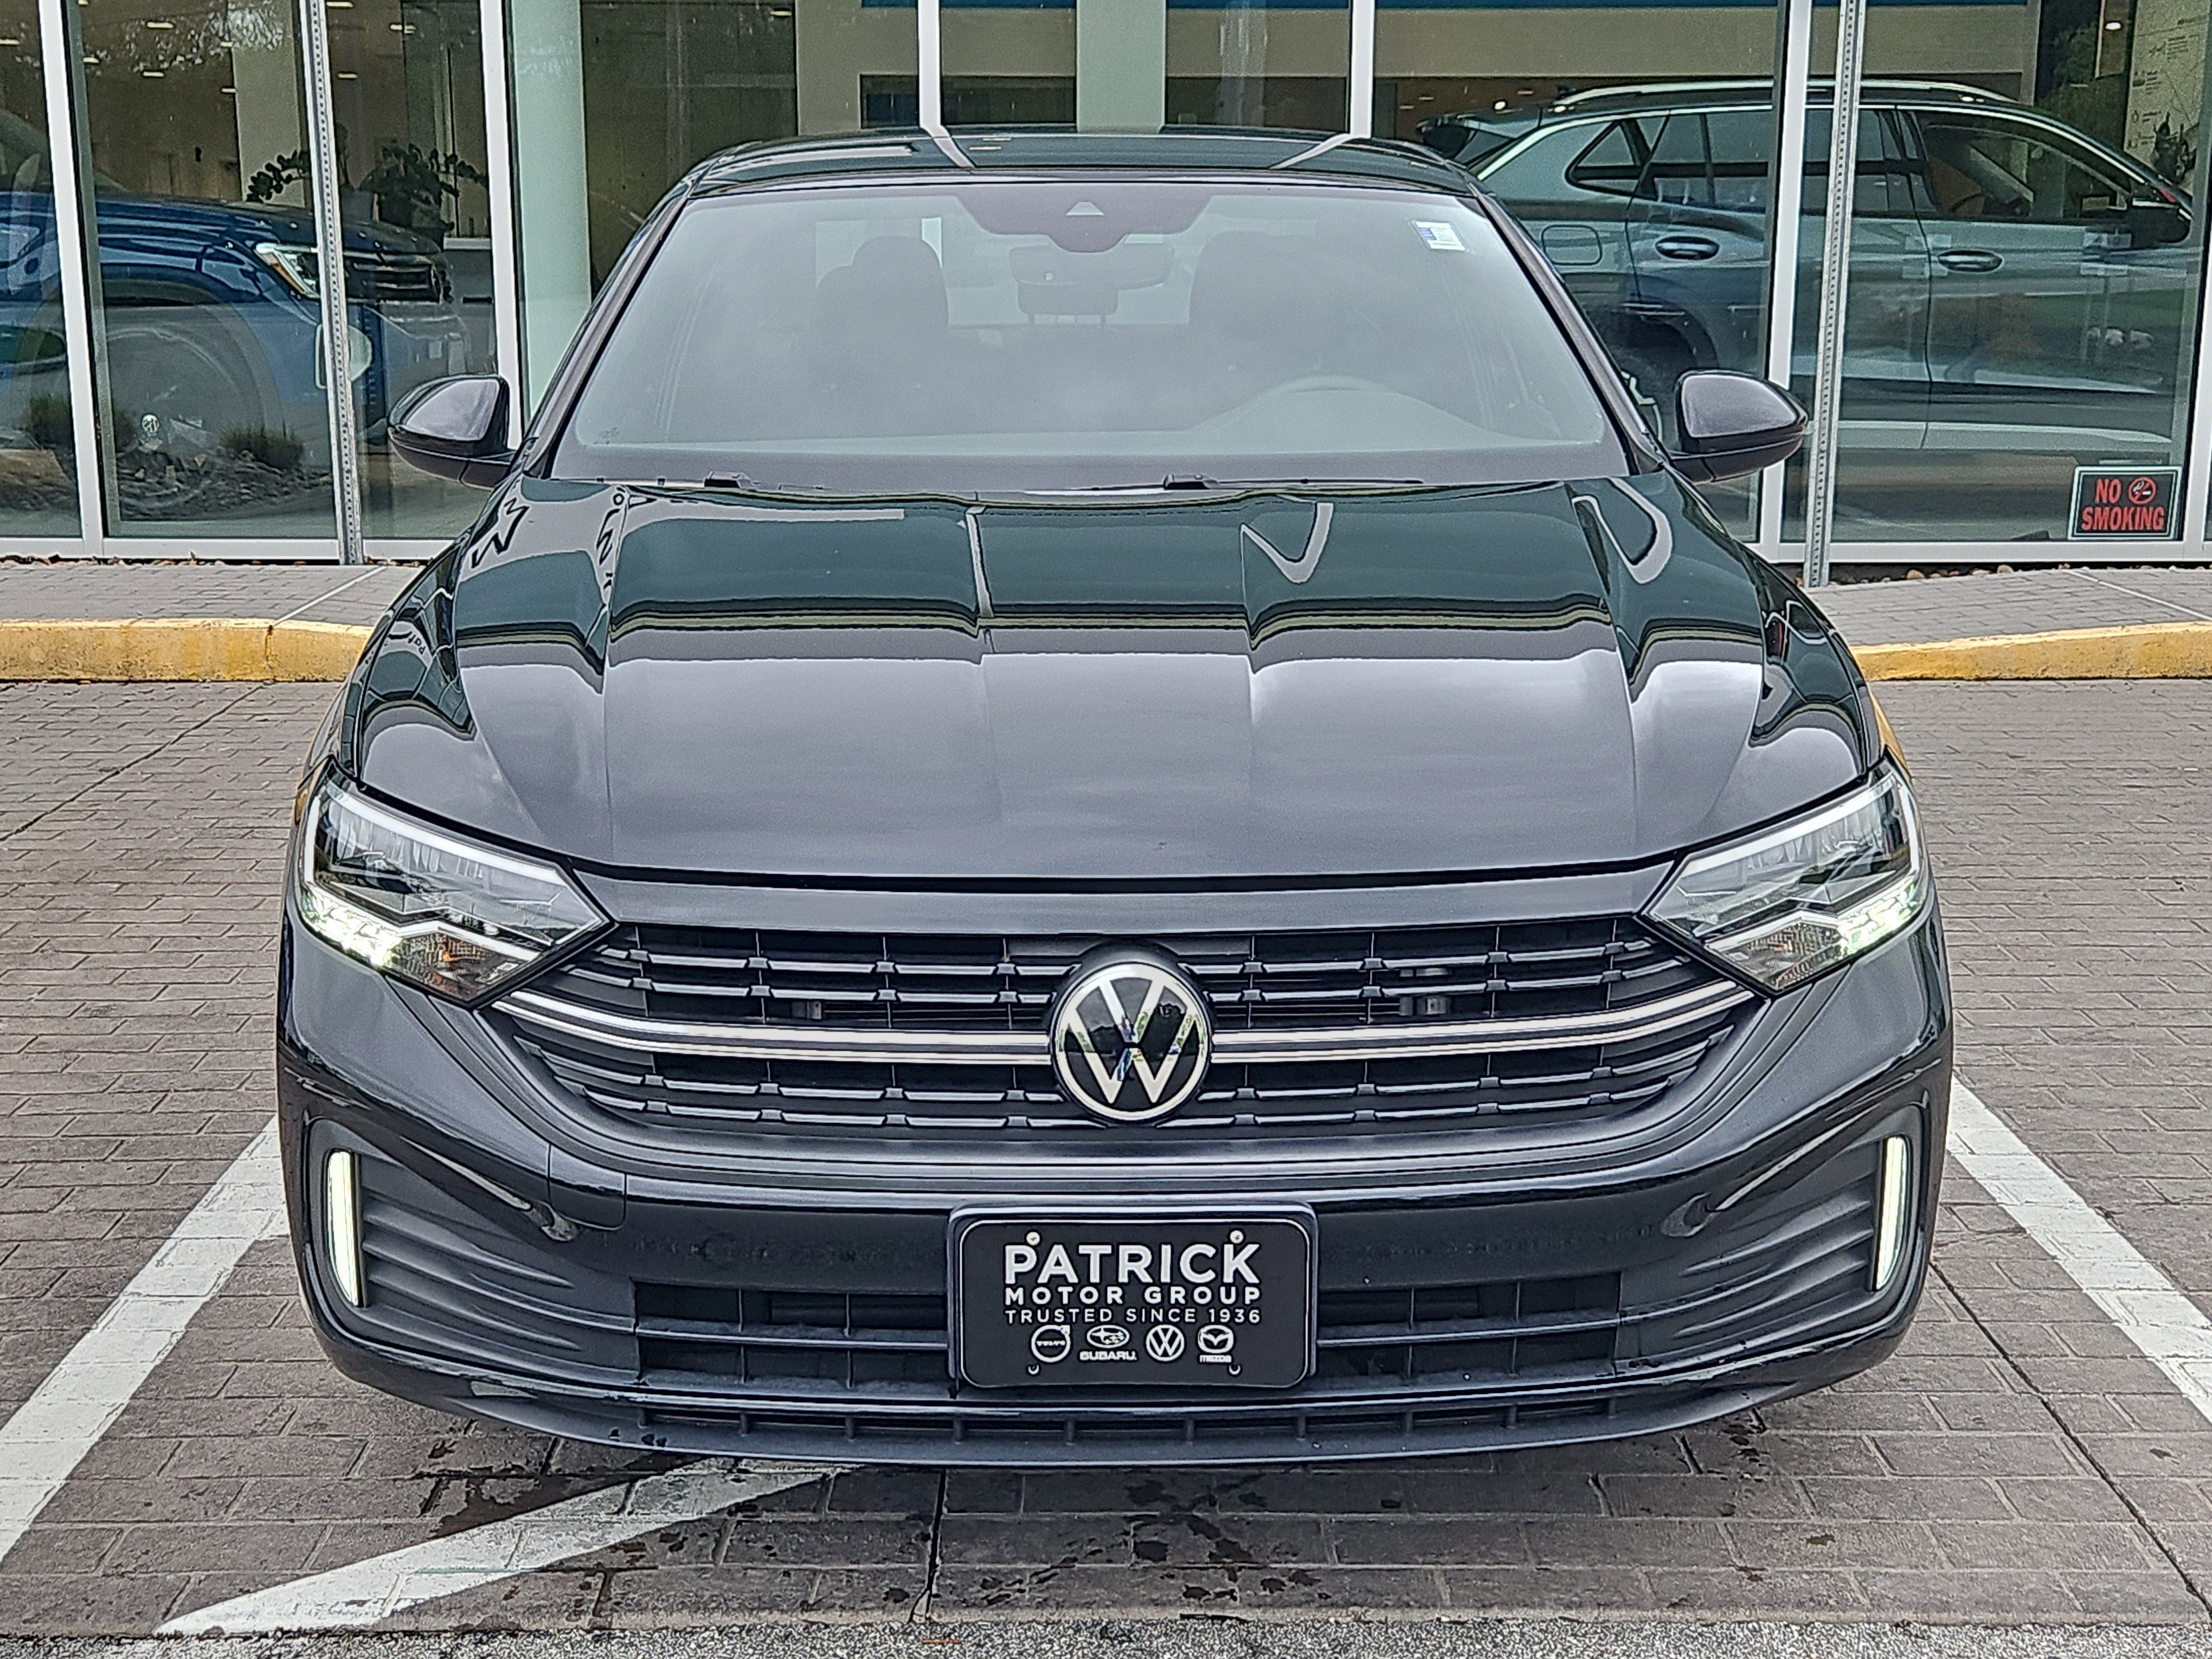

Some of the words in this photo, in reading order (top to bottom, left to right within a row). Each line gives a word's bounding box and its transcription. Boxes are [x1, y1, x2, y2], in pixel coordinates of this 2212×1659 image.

[2094, 478, 2122, 503] NO
[2081, 506, 2165, 531] SMOKING
[1005, 1244, 1260, 1284] PATRICK
[1005, 1287, 1123, 1305] MOTOR
[1144, 1287, 1261, 1304] GROUP
[1005, 1309, 1112, 1323] TRUSTED
[1126, 1308, 1196, 1322] SINCE
[1209, 1309, 1260, 1323] 1936
[1079, 1351, 1137, 1360] SUBARU
